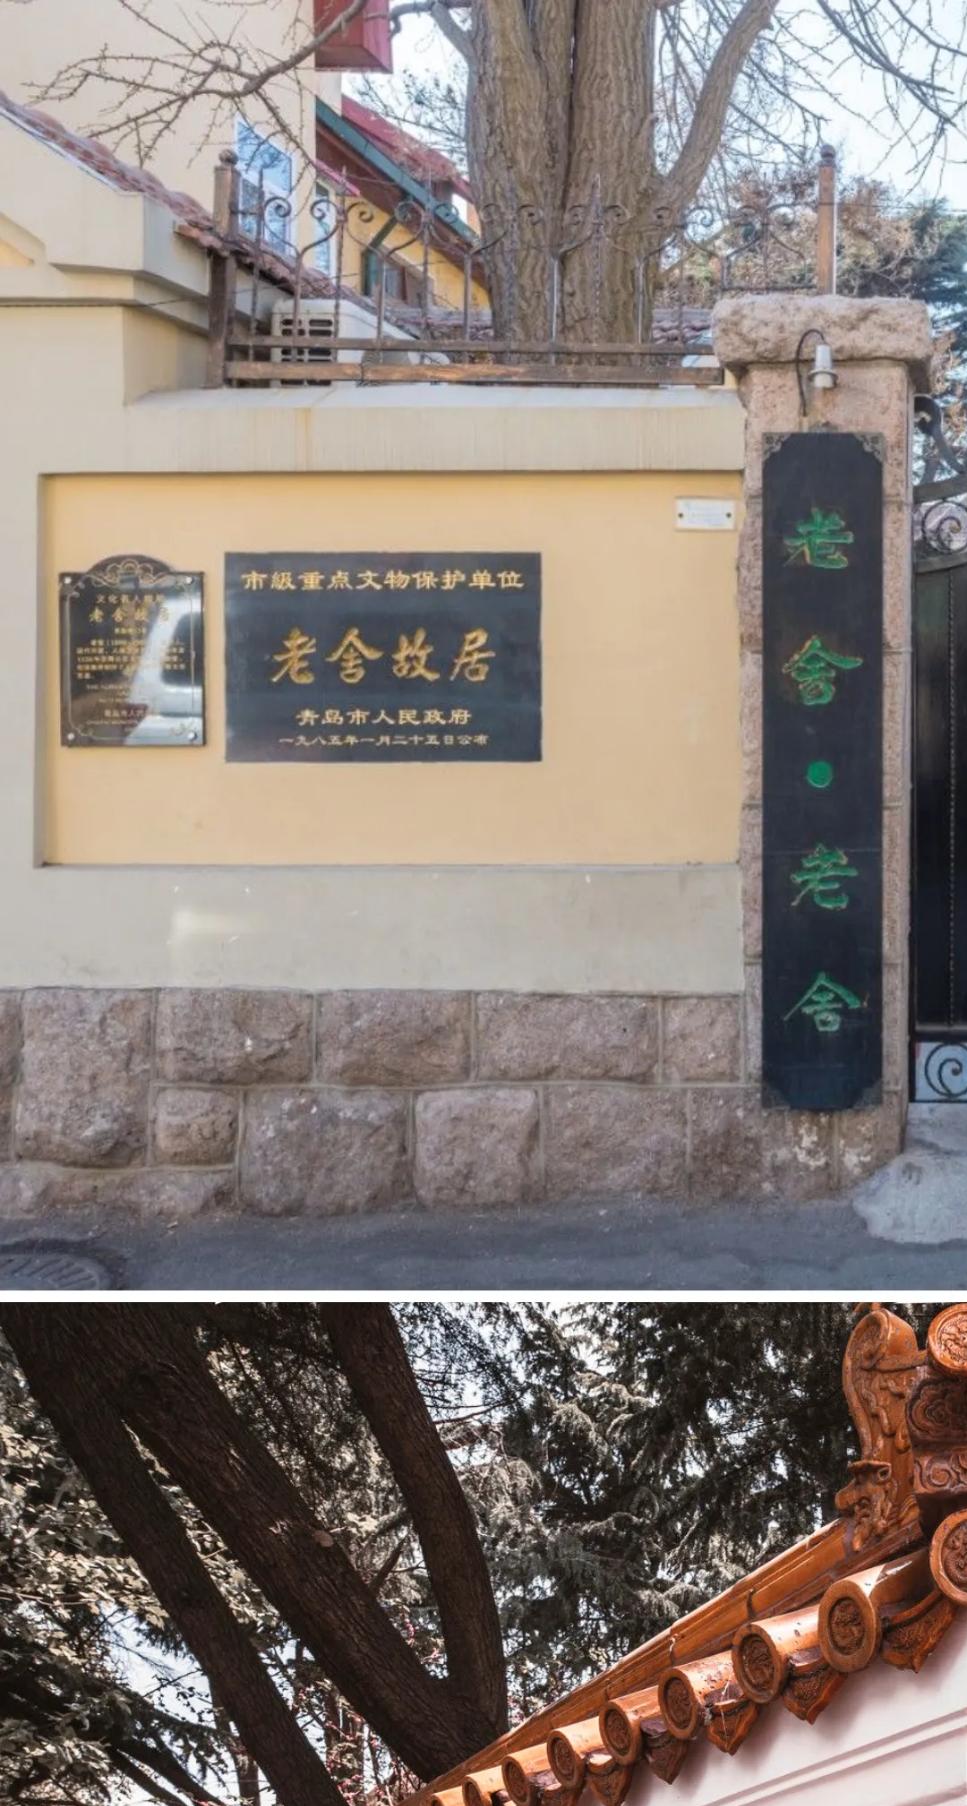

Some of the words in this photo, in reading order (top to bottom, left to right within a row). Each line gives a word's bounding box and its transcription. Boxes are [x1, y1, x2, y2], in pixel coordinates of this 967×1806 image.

[271, 626, 497, 685] 老舍故居
[296, 708, 472, 727] 青岛市人民政府
[278, 733, 489, 747] 一九八五年一月二十五日公布
